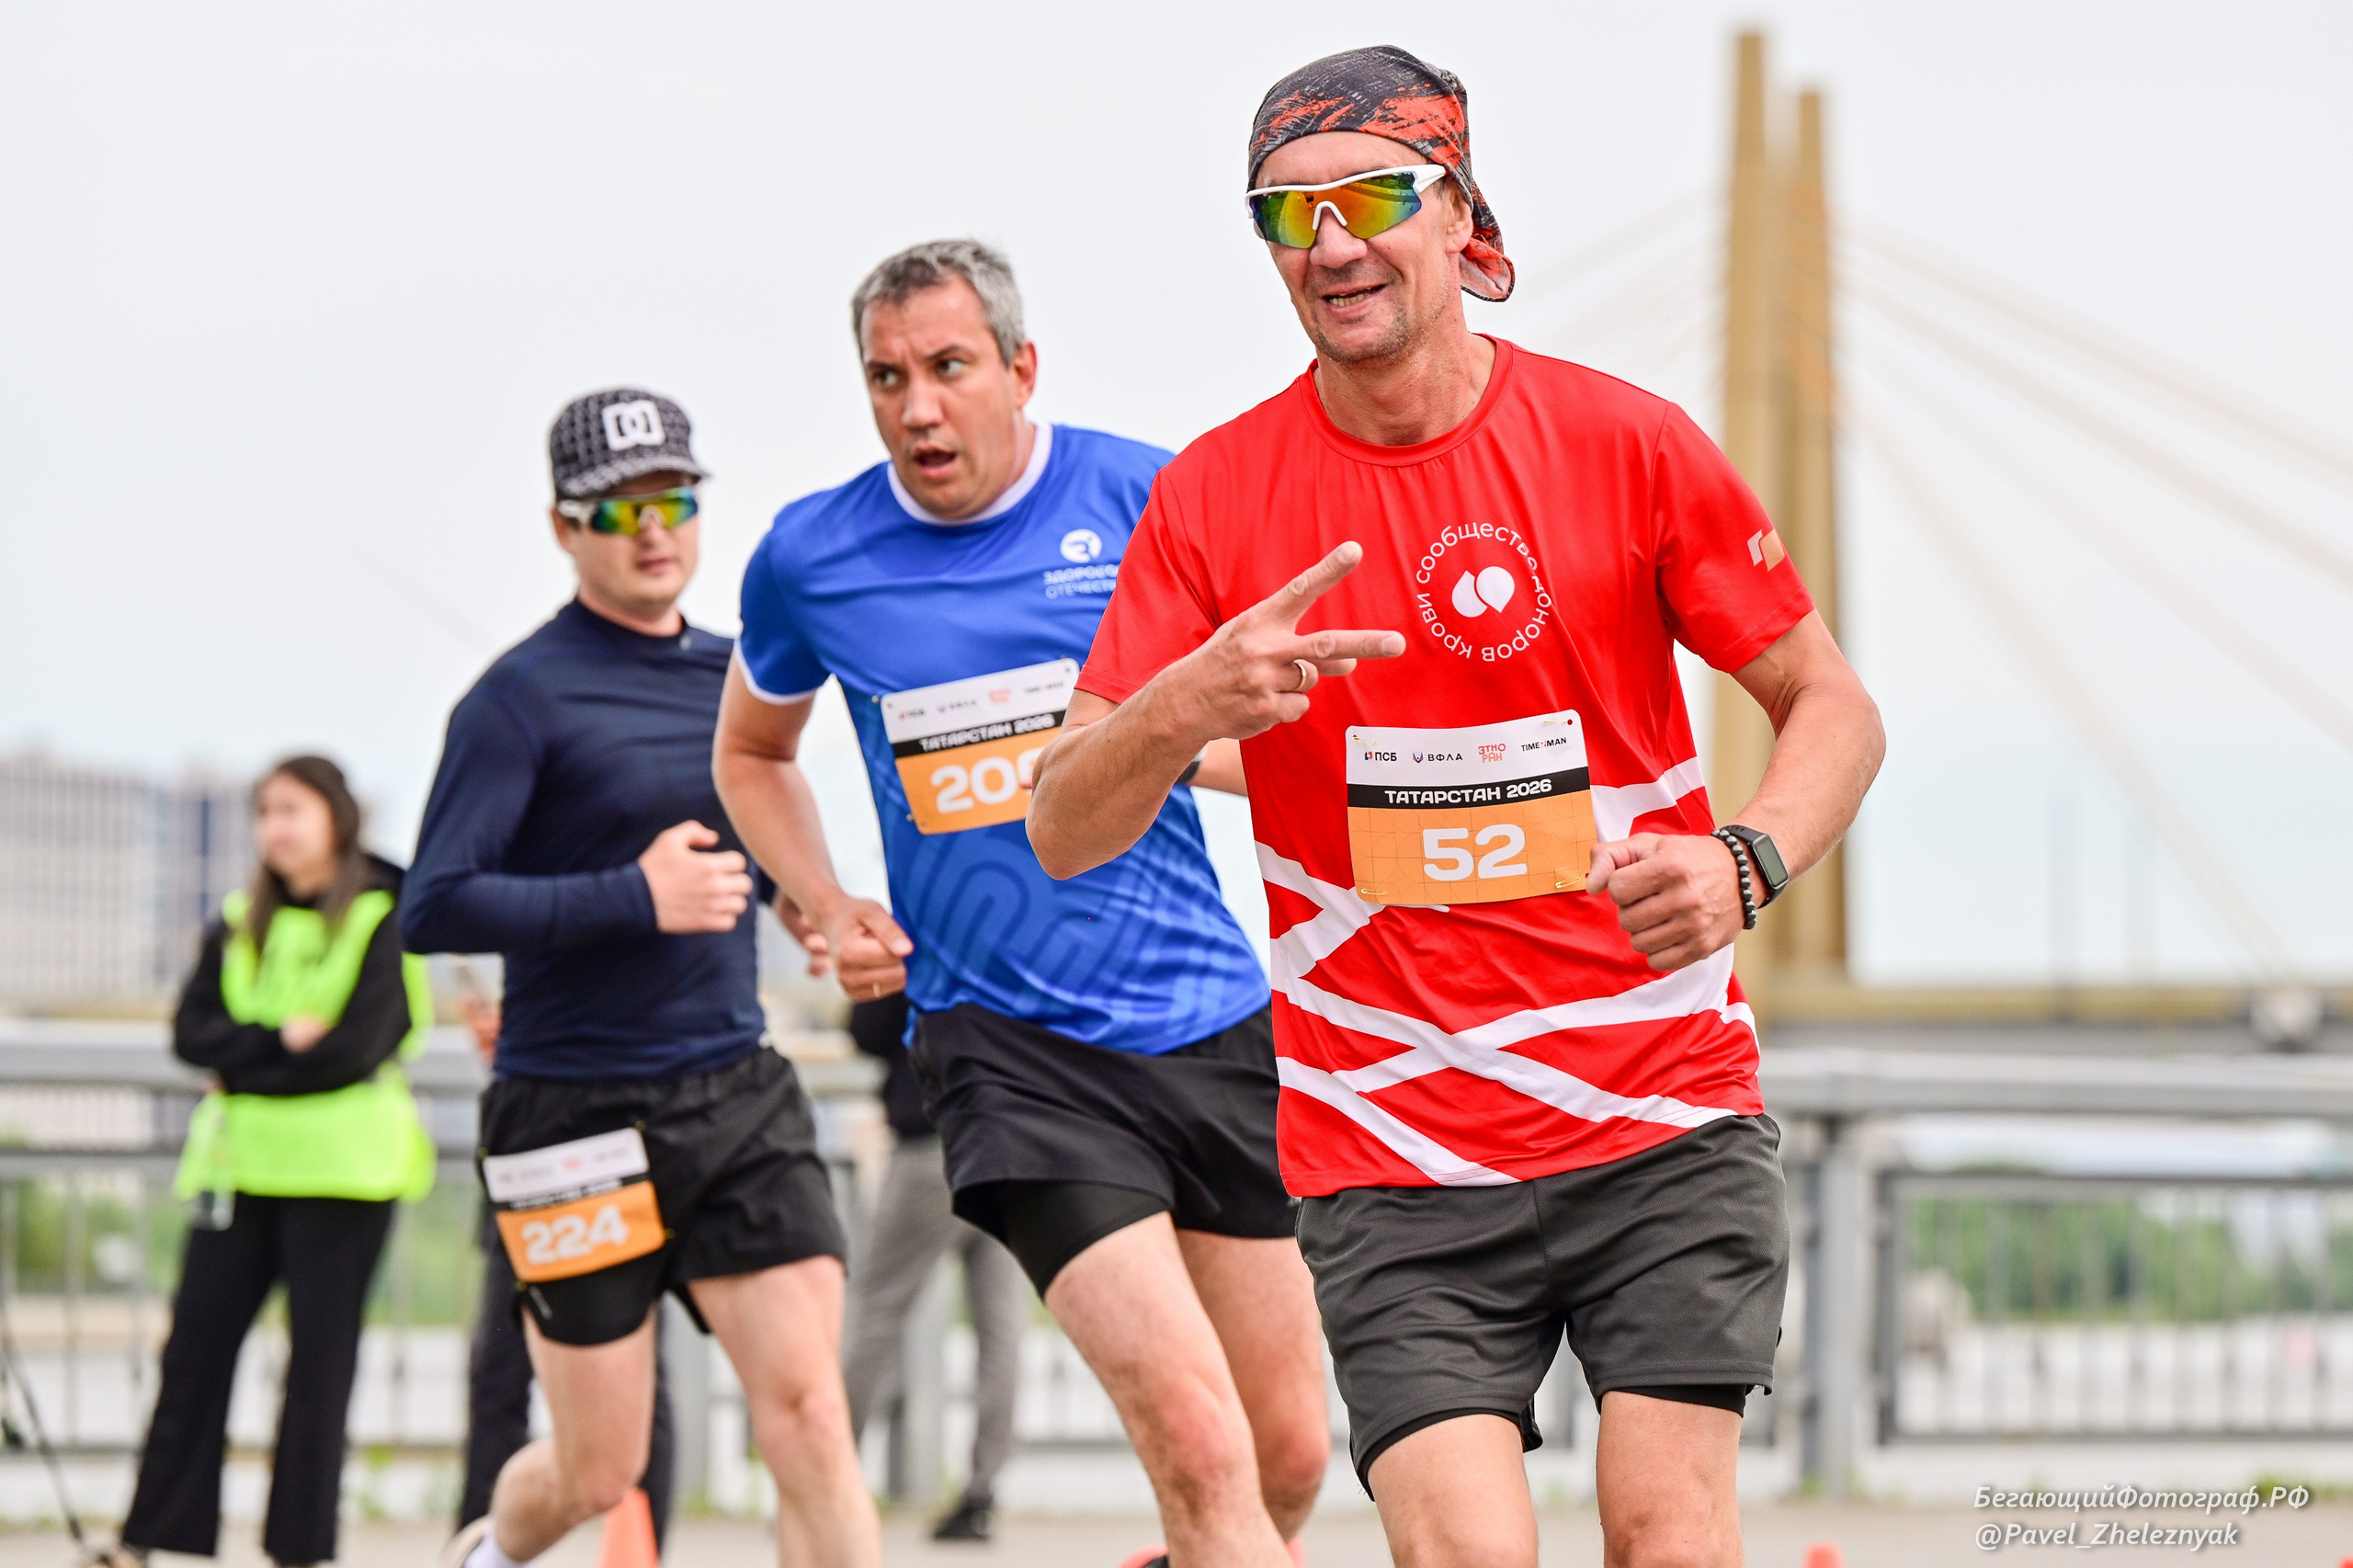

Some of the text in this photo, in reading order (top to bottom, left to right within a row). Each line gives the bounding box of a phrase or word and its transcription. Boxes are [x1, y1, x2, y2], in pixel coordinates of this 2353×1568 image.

[1416, 592, 1472, 659] крови
[1374, 752, 1463, 762] ПСБ ВФЛА
[1478, 743, 1506, 755] ЭТНО
[1482, 752, 1503, 763] РАН
[1384, 778, 1552, 804] ТАТАРСТАН 2026
[1422, 824, 1528, 881] 52
[521, 1204, 631, 1265] 224
